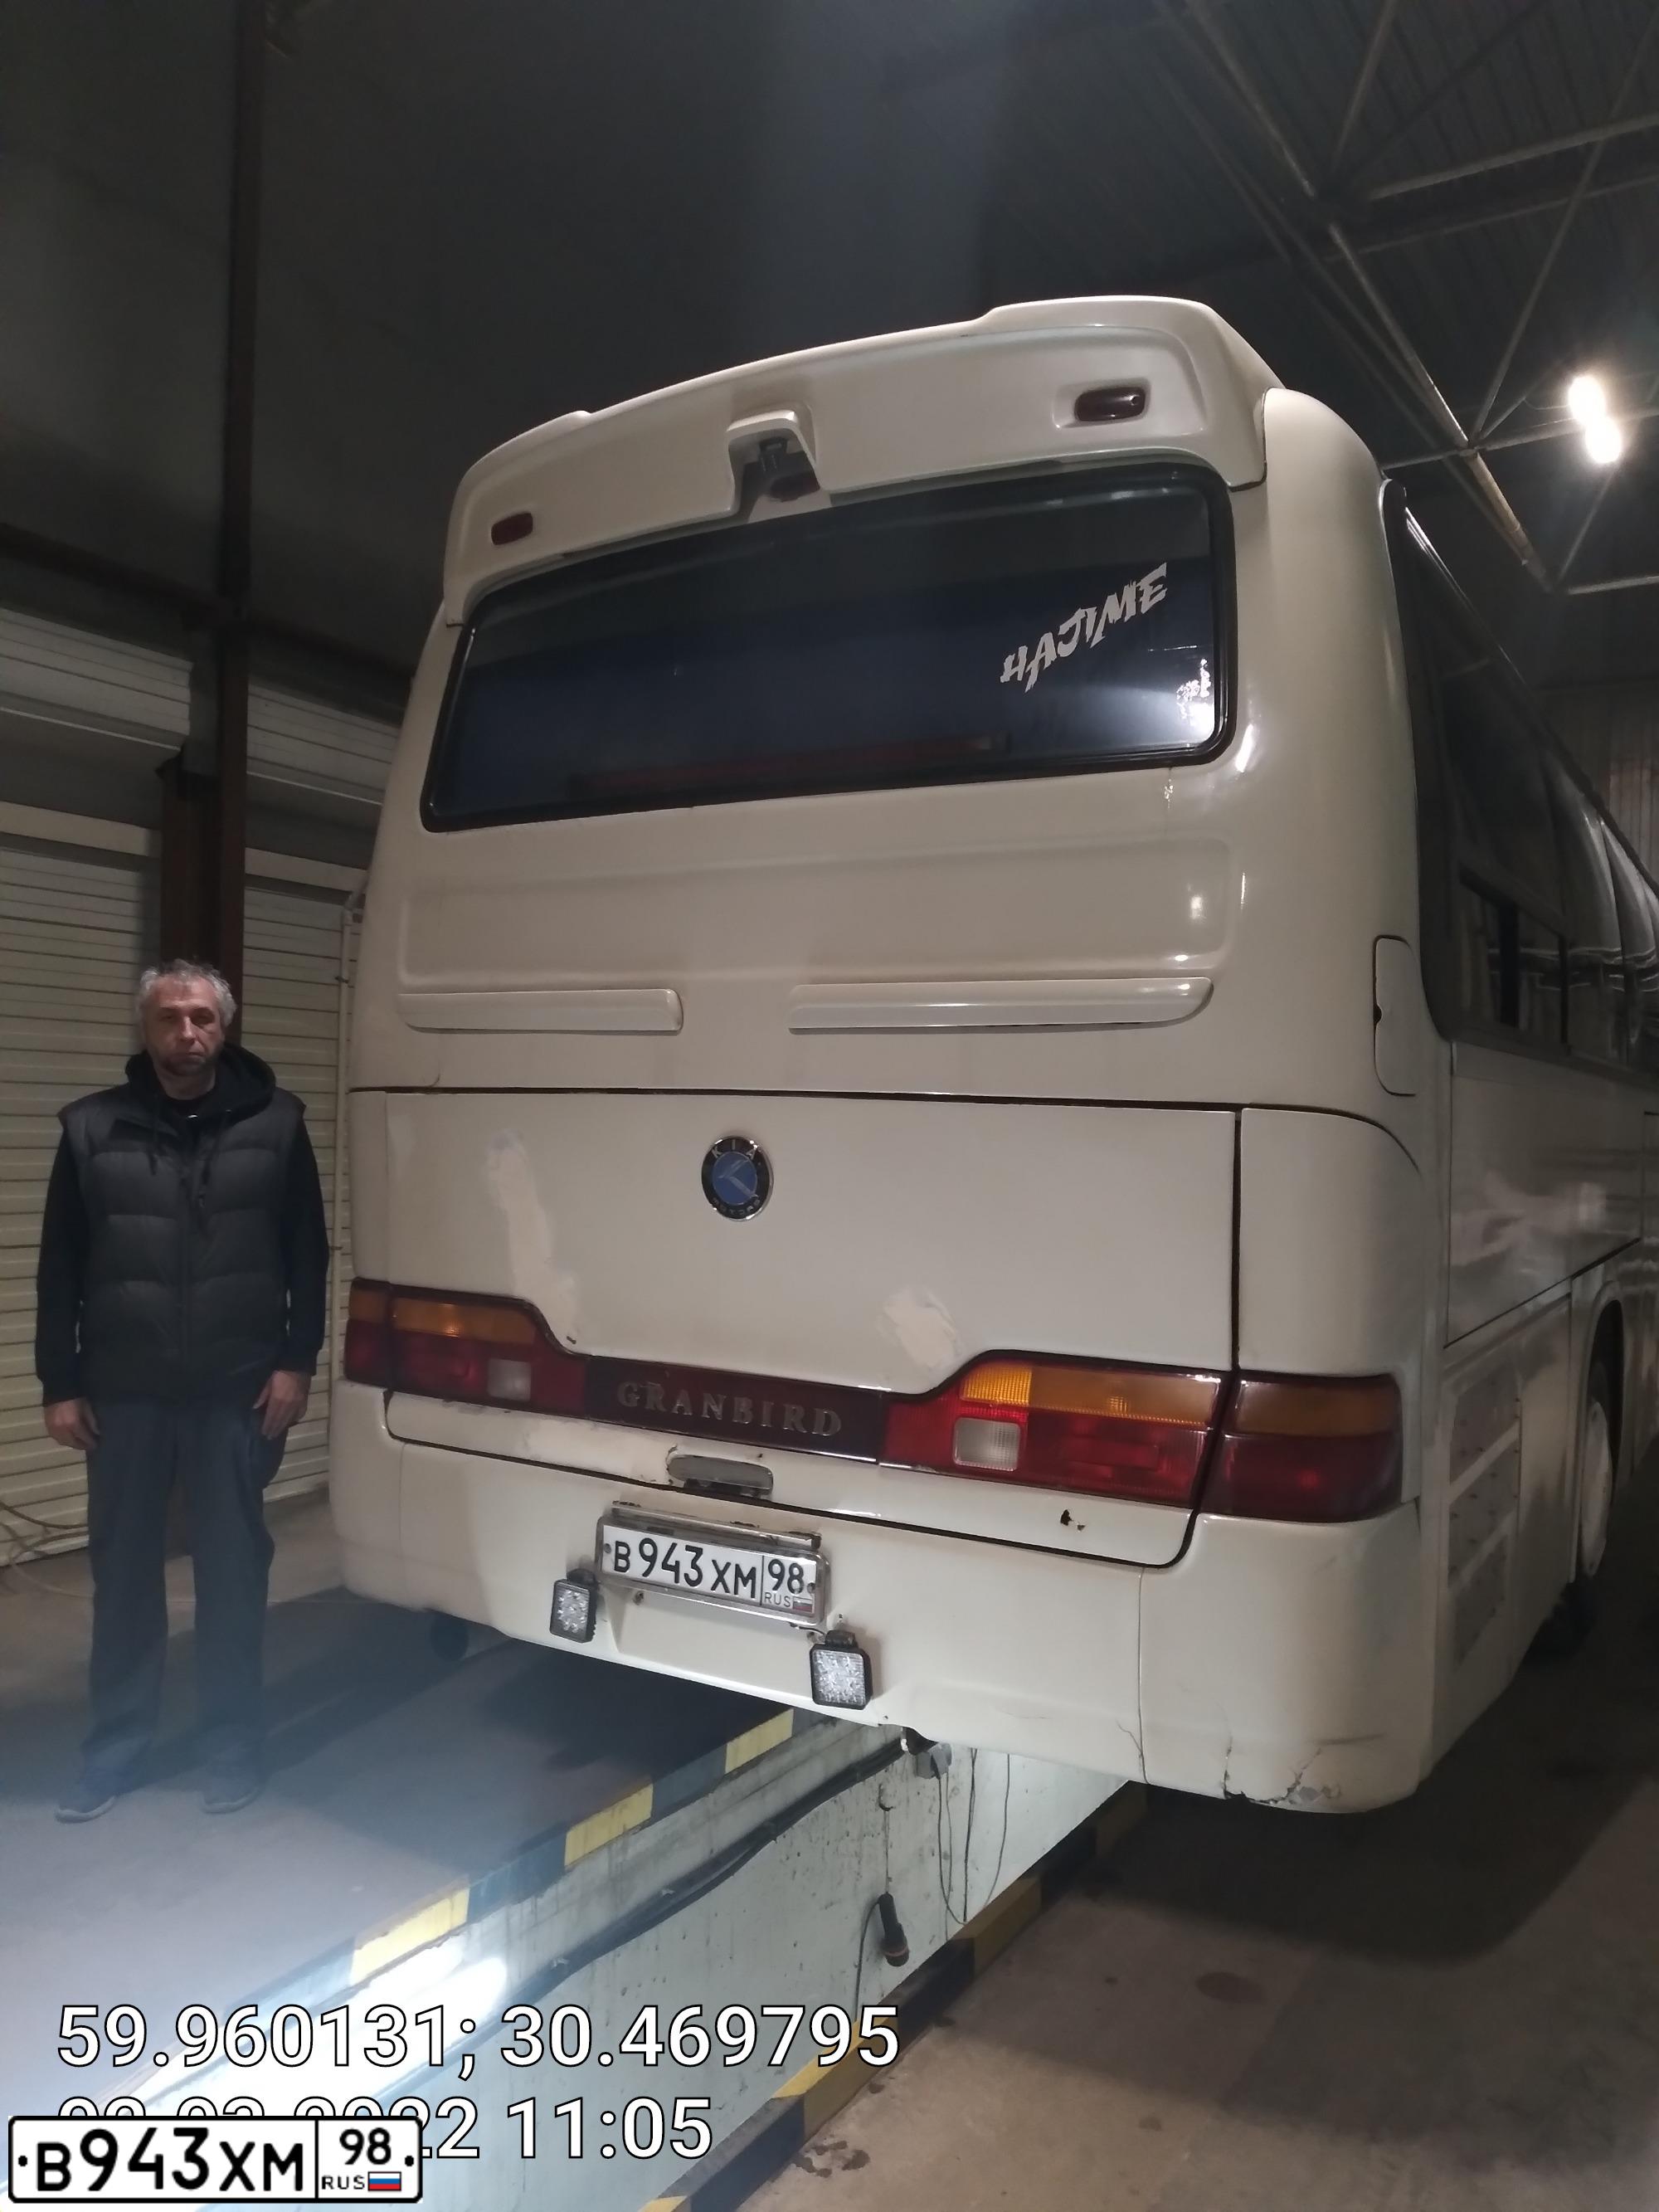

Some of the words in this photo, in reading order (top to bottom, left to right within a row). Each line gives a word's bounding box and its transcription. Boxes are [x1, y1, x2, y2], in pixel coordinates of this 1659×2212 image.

[1000, 563, 1167, 692] HAJIME
[712, 1139, 757, 1160] KIA
[617, 1381, 842, 1436] GRANBIRD
[767, 1558, 805, 1595] 98
[764, 1591, 791, 1608] RUS
